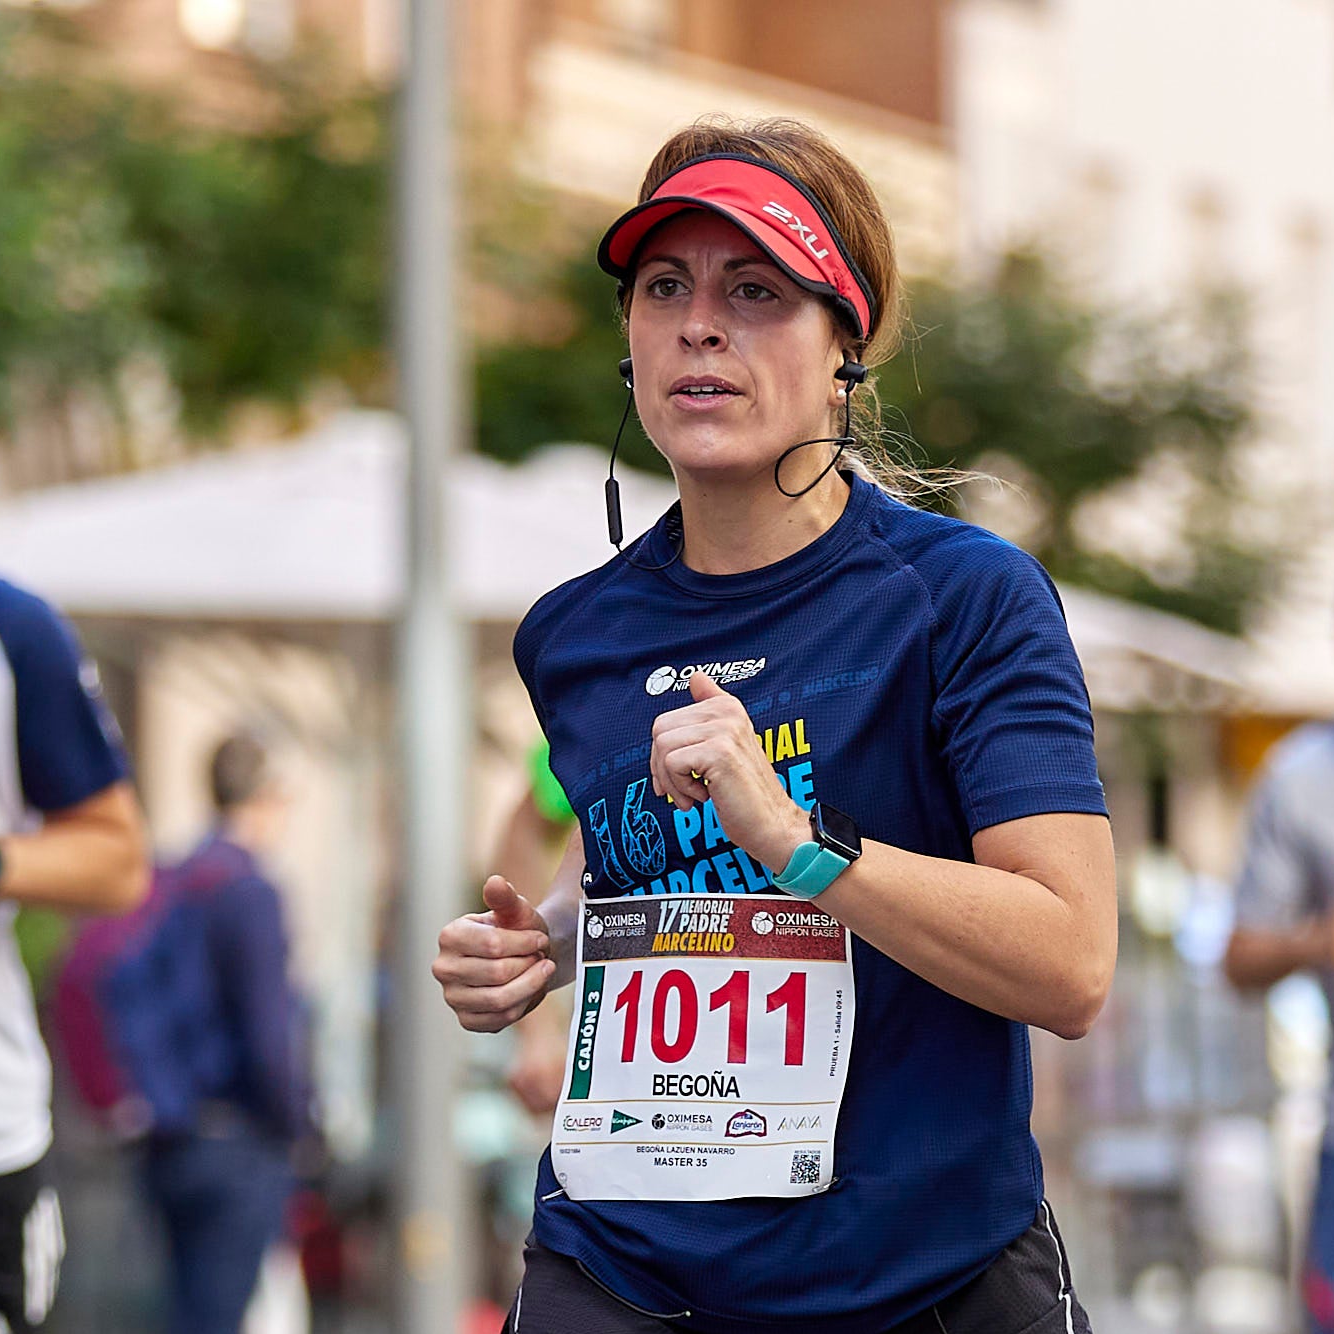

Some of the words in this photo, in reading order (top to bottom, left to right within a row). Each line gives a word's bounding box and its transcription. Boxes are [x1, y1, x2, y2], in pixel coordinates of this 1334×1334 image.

[763, 201, 829, 260] 2XU
[680, 658, 766, 678] OXIMESA
[588, 778, 667, 889] 16
[680, 900, 734, 914] MEMORIAL
[604, 913, 647, 927] OXIMESA
[657, 900, 682, 934] 17
[678, 913, 730, 933] PADRE
[775, 912, 840, 927] OXIMESA
[604, 928, 625, 938] NIPPON
[626, 927, 647, 937] GASES
[775, 927, 809, 936] NIPPON
[811, 929, 840, 938] GASES
[651, 932, 735, 952] MARCELINO
[614, 969, 807, 1066] 1011
[578, 1010, 597, 1071] CAJÓN
[588, 991, 600, 1003] 3
[652, 1071, 741, 1098] BEGOÑA
[566, 1117, 603, 1128] CALERO
[667, 1114, 713, 1124] OXIMESA
[636, 1145, 665, 1153] BEGOÑA
[667, 1146, 696, 1154] LAZUEN
[697, 1147, 736, 1155] NAVARRO
[654, 1157, 693, 1167] MASTER
[696, 1158, 708, 1167] 35
